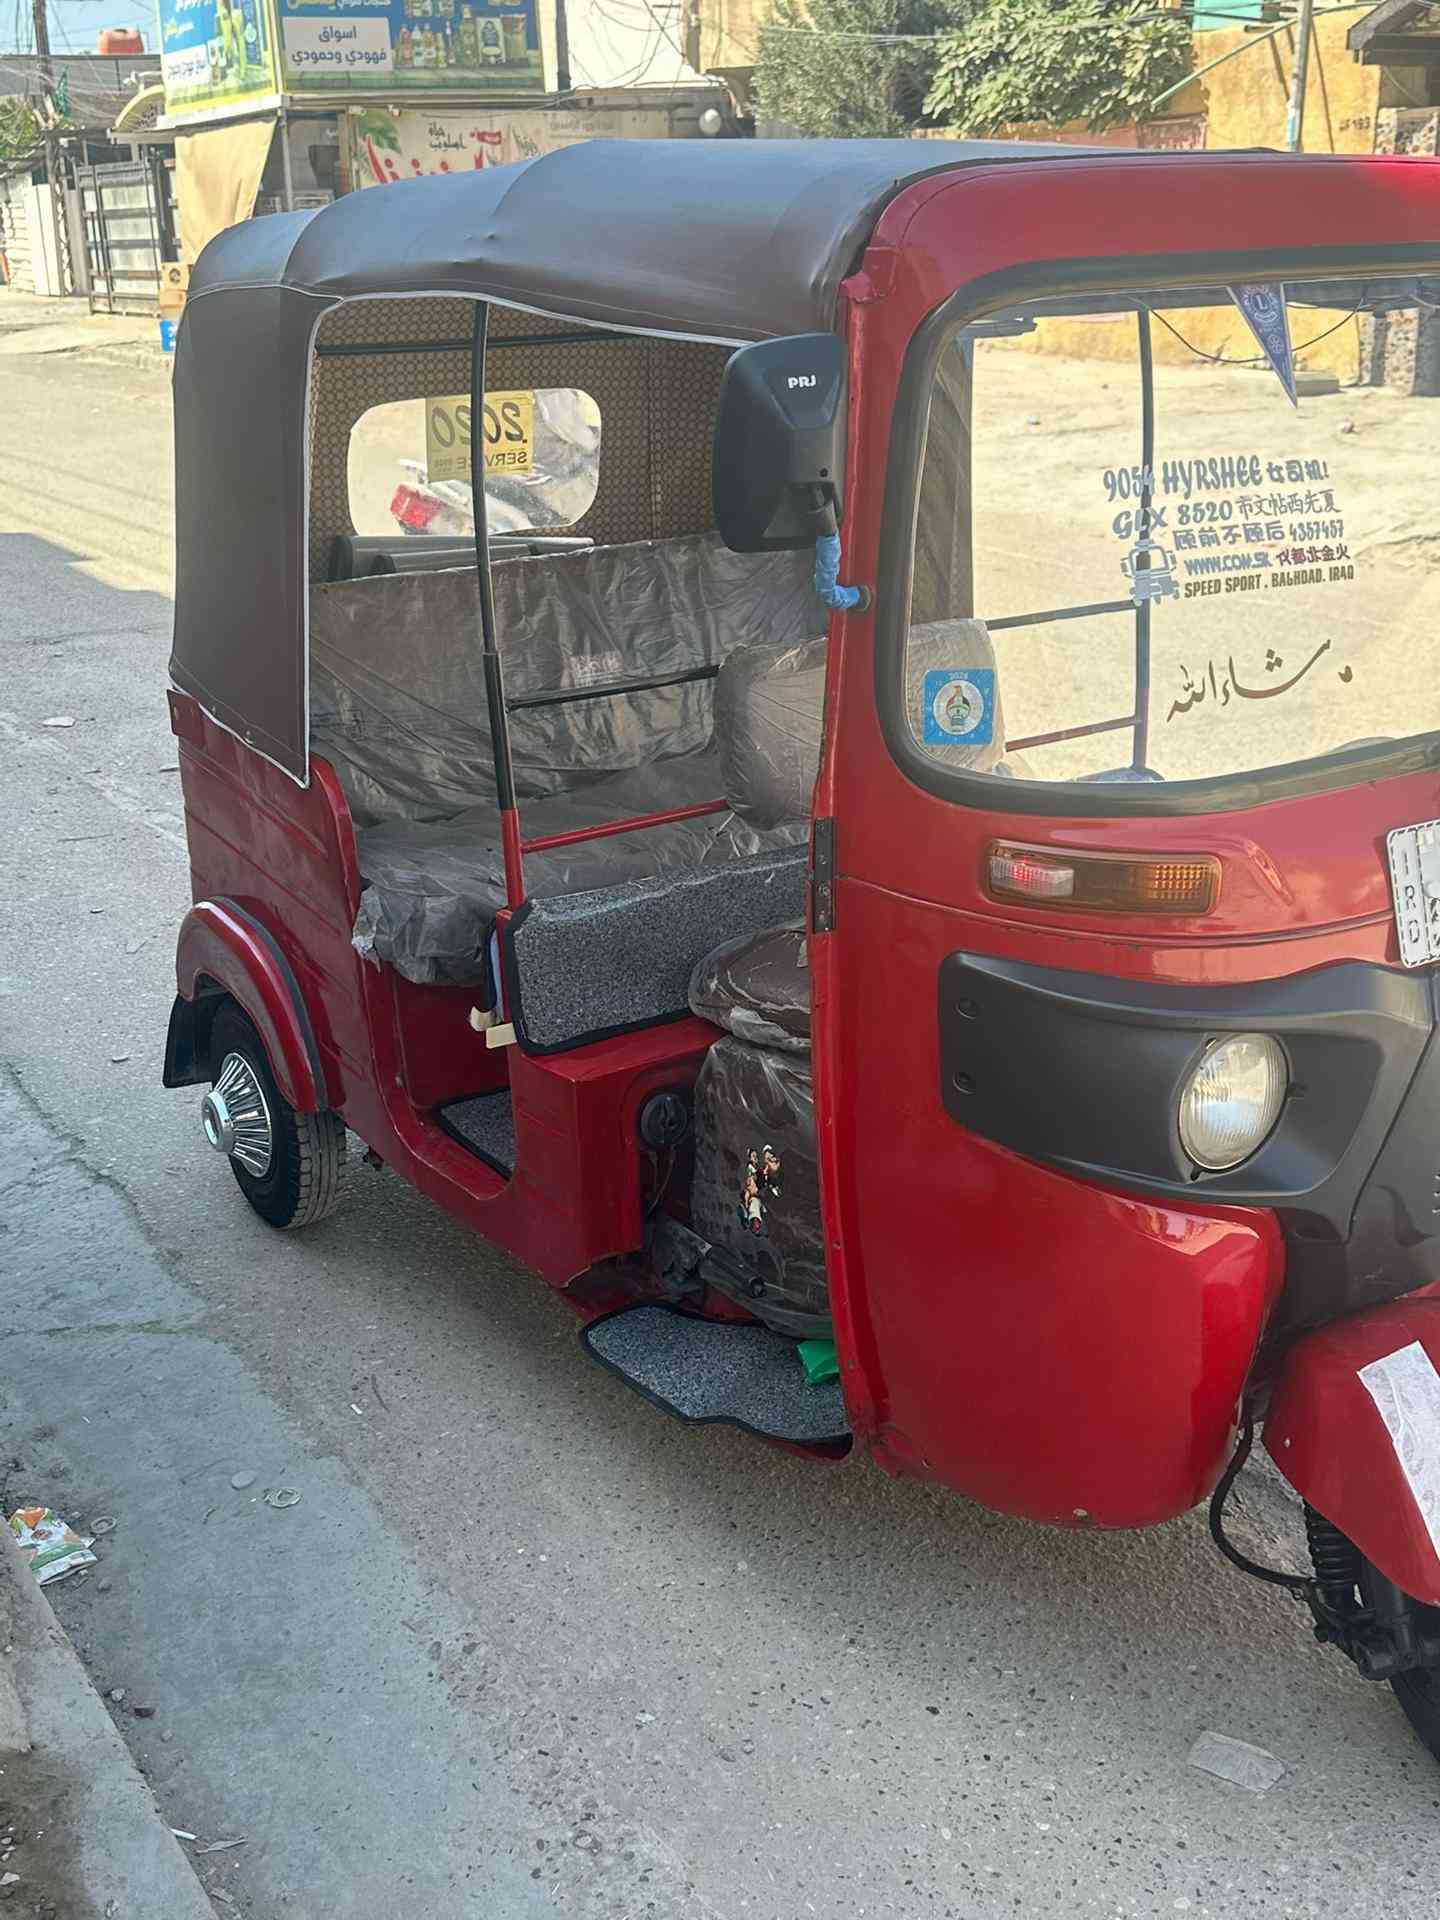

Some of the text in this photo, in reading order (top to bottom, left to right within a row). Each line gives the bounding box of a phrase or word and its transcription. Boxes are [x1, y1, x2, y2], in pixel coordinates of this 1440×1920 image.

[318, 25, 357, 42] اسواق
[787, 374, 817, 389] PRJ
[1177, 499, 1234, 526] 8520
[1184, 578, 1222, 599] SPEED
[1328, 564, 1355, 583] IRAQ
